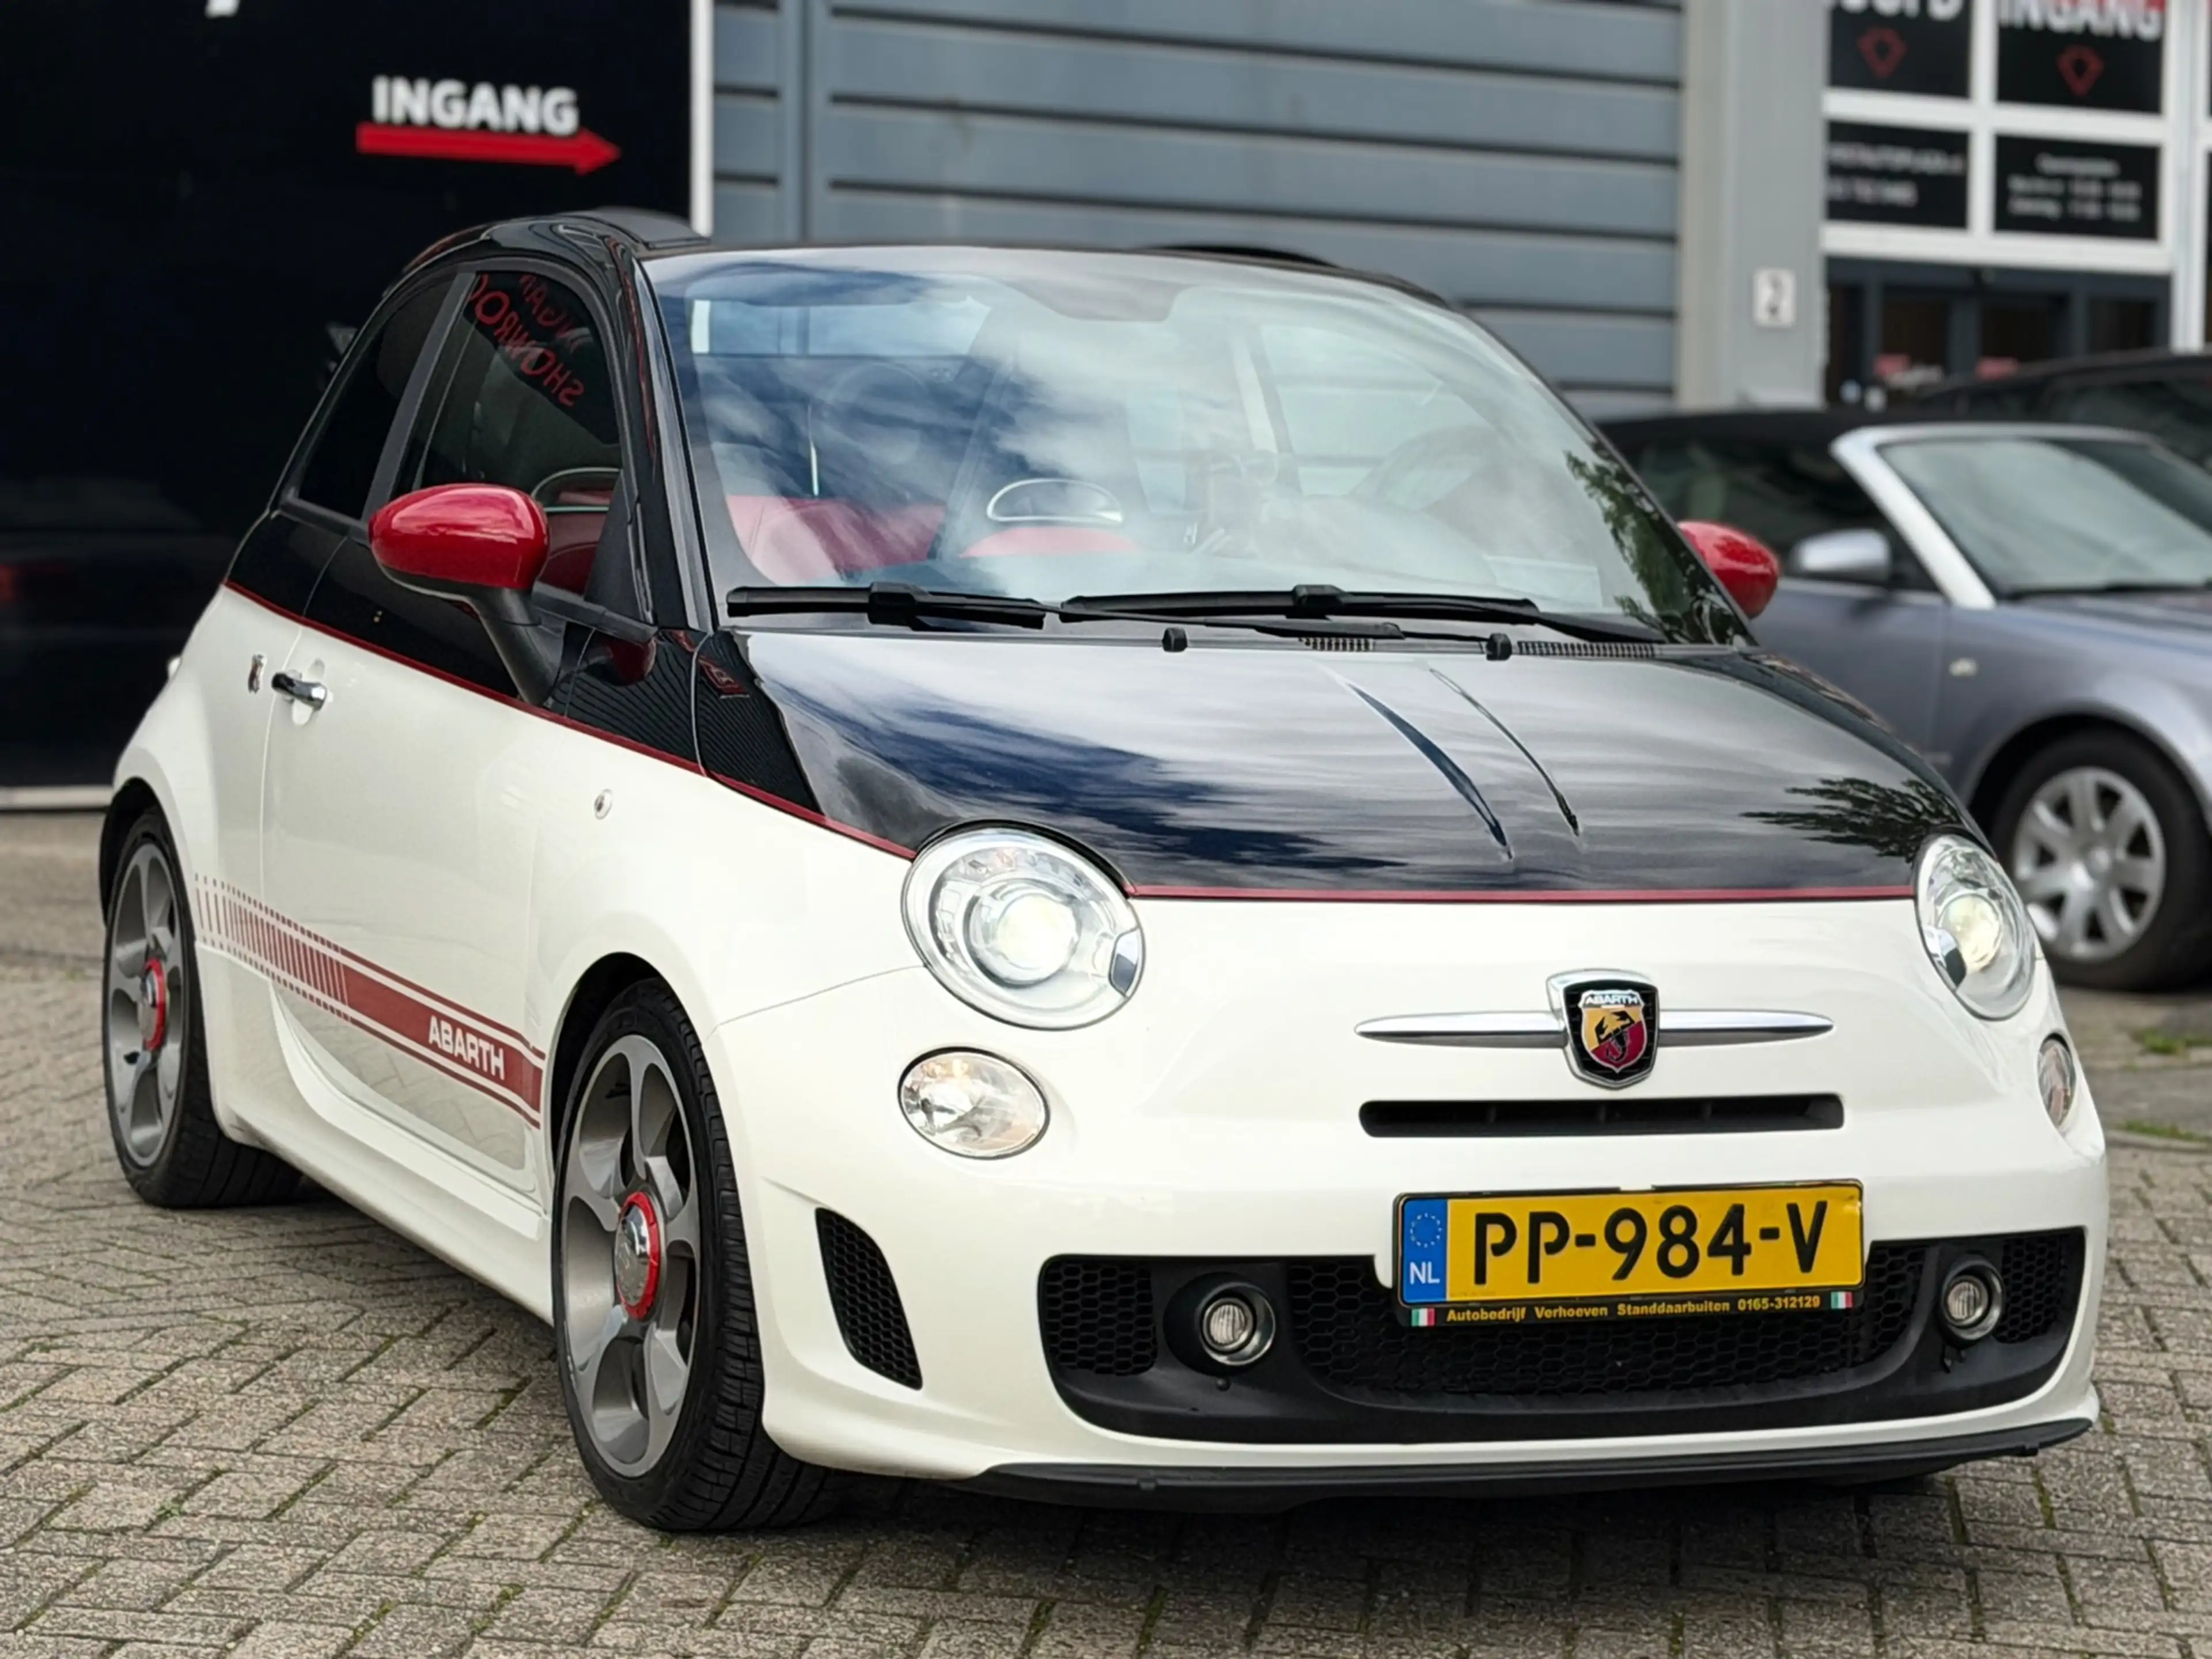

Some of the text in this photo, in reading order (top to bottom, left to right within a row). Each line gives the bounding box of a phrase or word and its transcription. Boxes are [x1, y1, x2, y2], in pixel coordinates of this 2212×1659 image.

[372, 74, 578, 136] INGANG
[1585, 994, 1638, 1005] ABARTH
[428, 1015, 505, 1080] ABARTH
[1410, 1200, 1828, 1285] NL PP-984-V
[1446, 1306, 1526, 1323] Autobedrijf
[1535, 1305, 1608, 1319] Verhoeven
[1616, 1301, 1730, 1316] Standdaarbuiten
